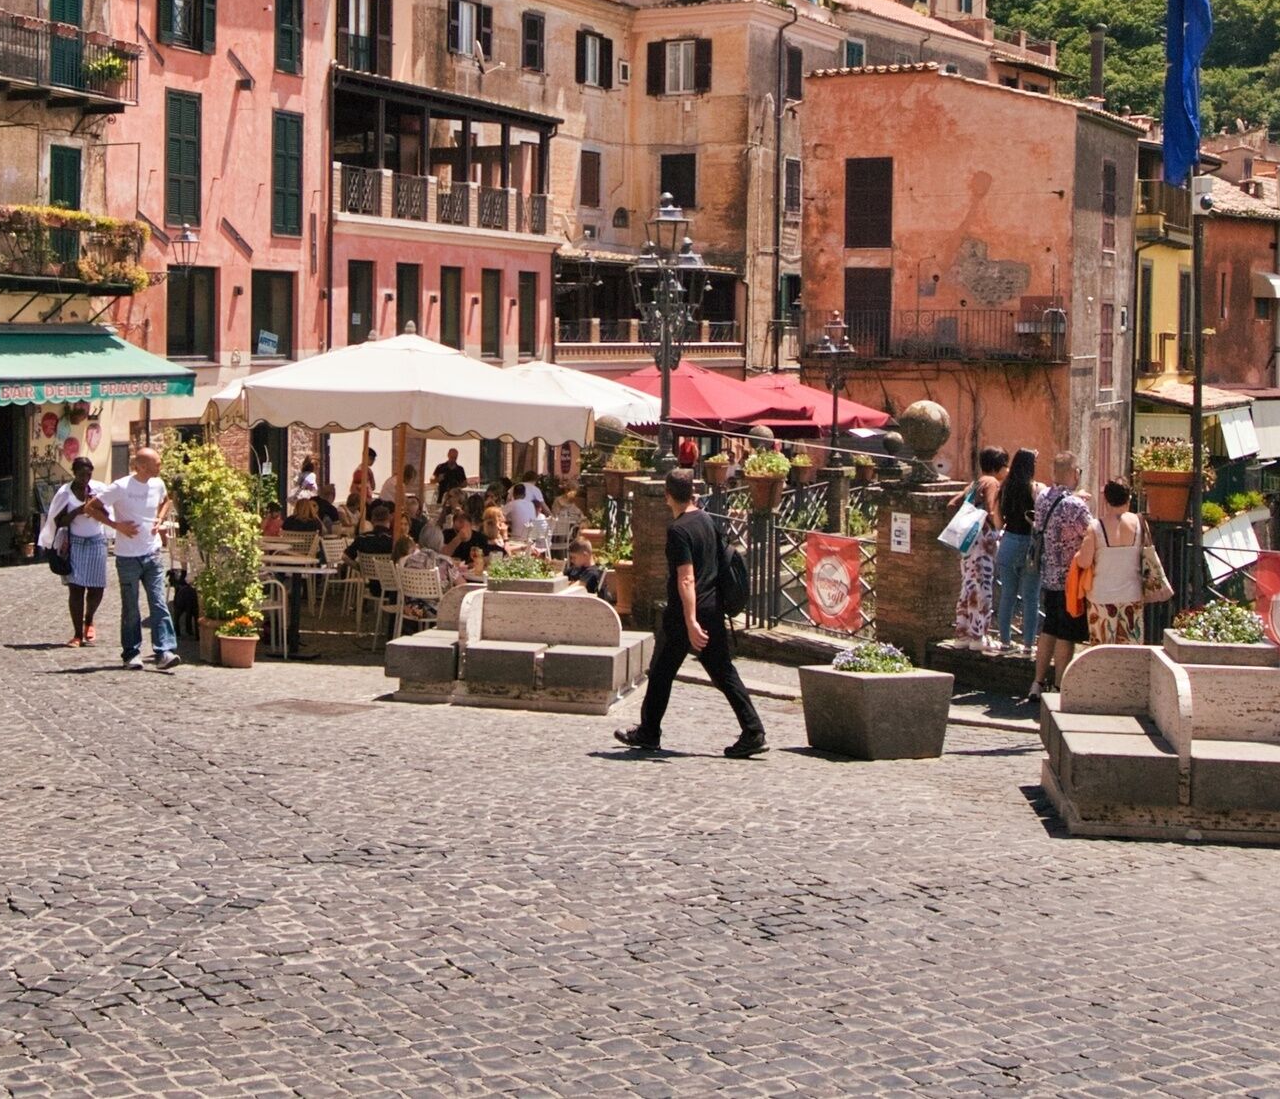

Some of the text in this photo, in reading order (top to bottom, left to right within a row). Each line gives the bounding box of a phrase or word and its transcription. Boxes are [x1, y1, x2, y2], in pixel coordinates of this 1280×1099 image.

[0, 380, 168, 400] BAR DELLE FRAGOLE
